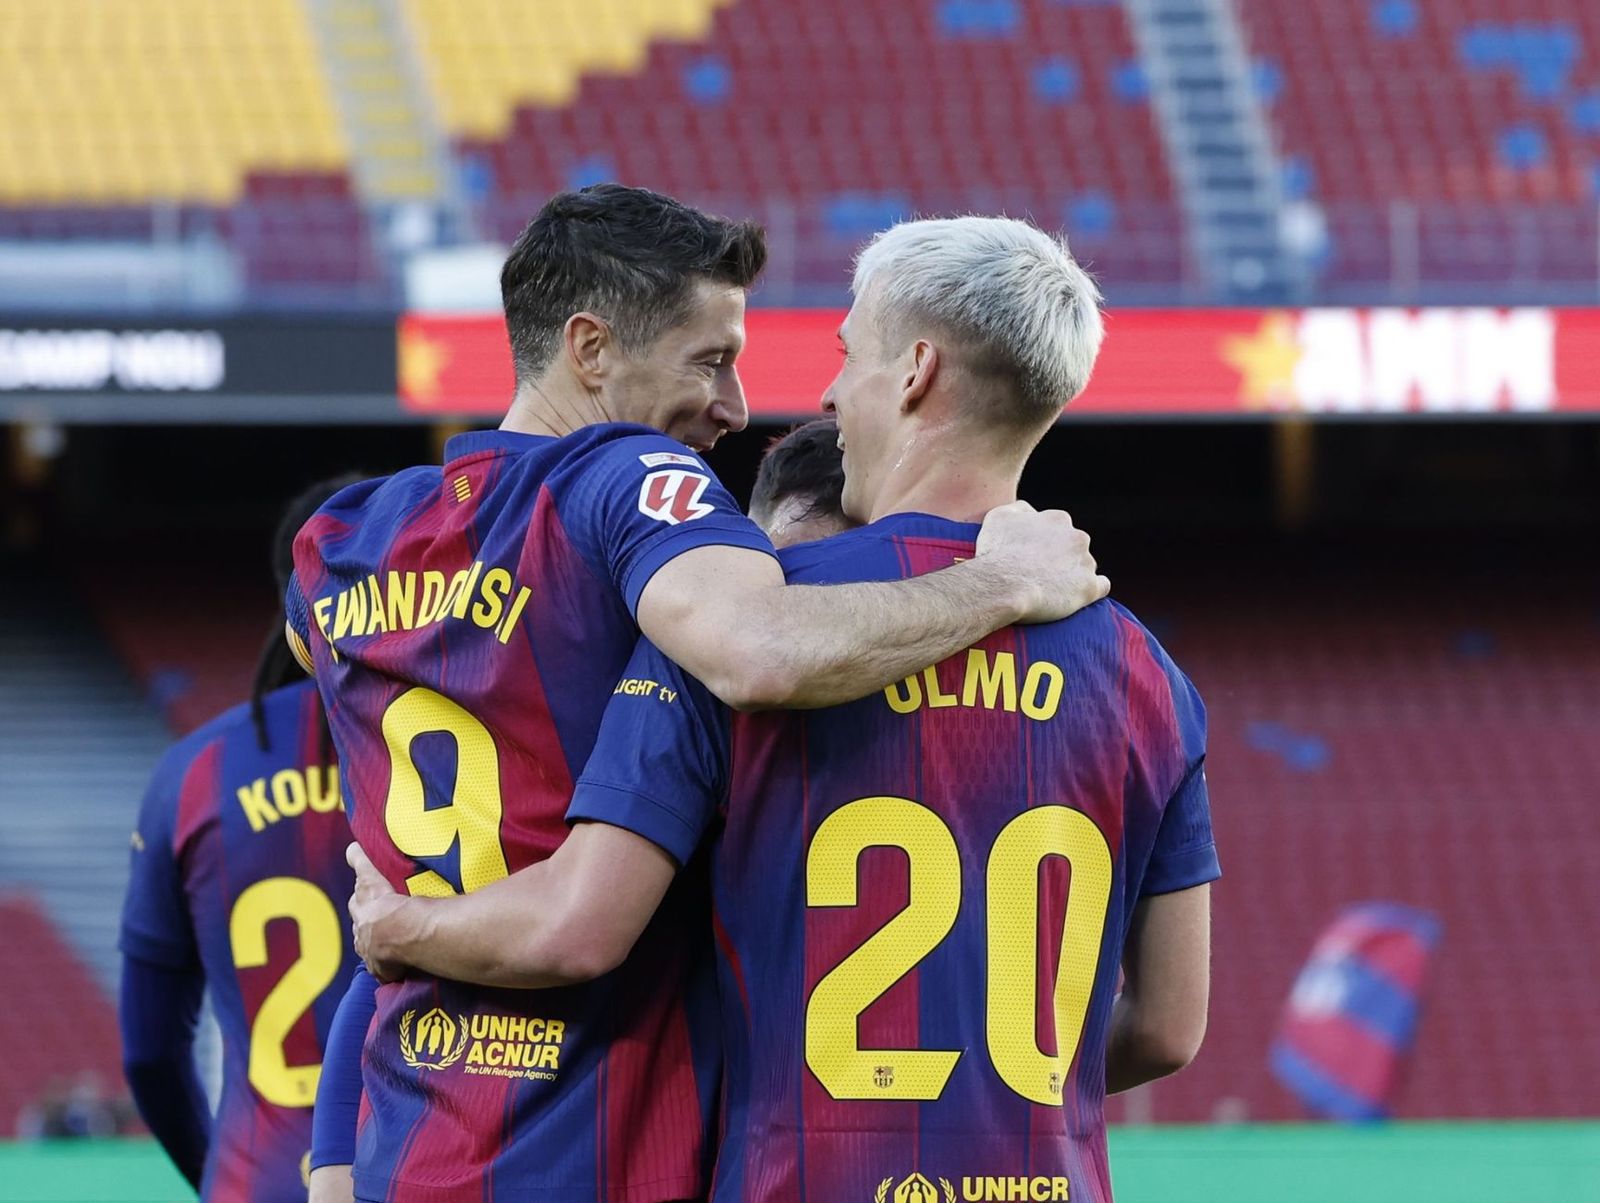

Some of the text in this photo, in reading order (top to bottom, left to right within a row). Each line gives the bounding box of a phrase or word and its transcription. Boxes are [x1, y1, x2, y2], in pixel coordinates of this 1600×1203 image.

[659, 686, 678, 703] tv
[382, 687, 510, 898] 9
[804, 796, 1113, 1107] 20
[229, 877, 341, 1108] 2
[471, 1014, 565, 1043] UNHCR
[465, 1041, 561, 1069] ACNUR
[464, 1066, 558, 1081] The UN Refugee Agency
[962, 1176, 1069, 1202] UNHCR
